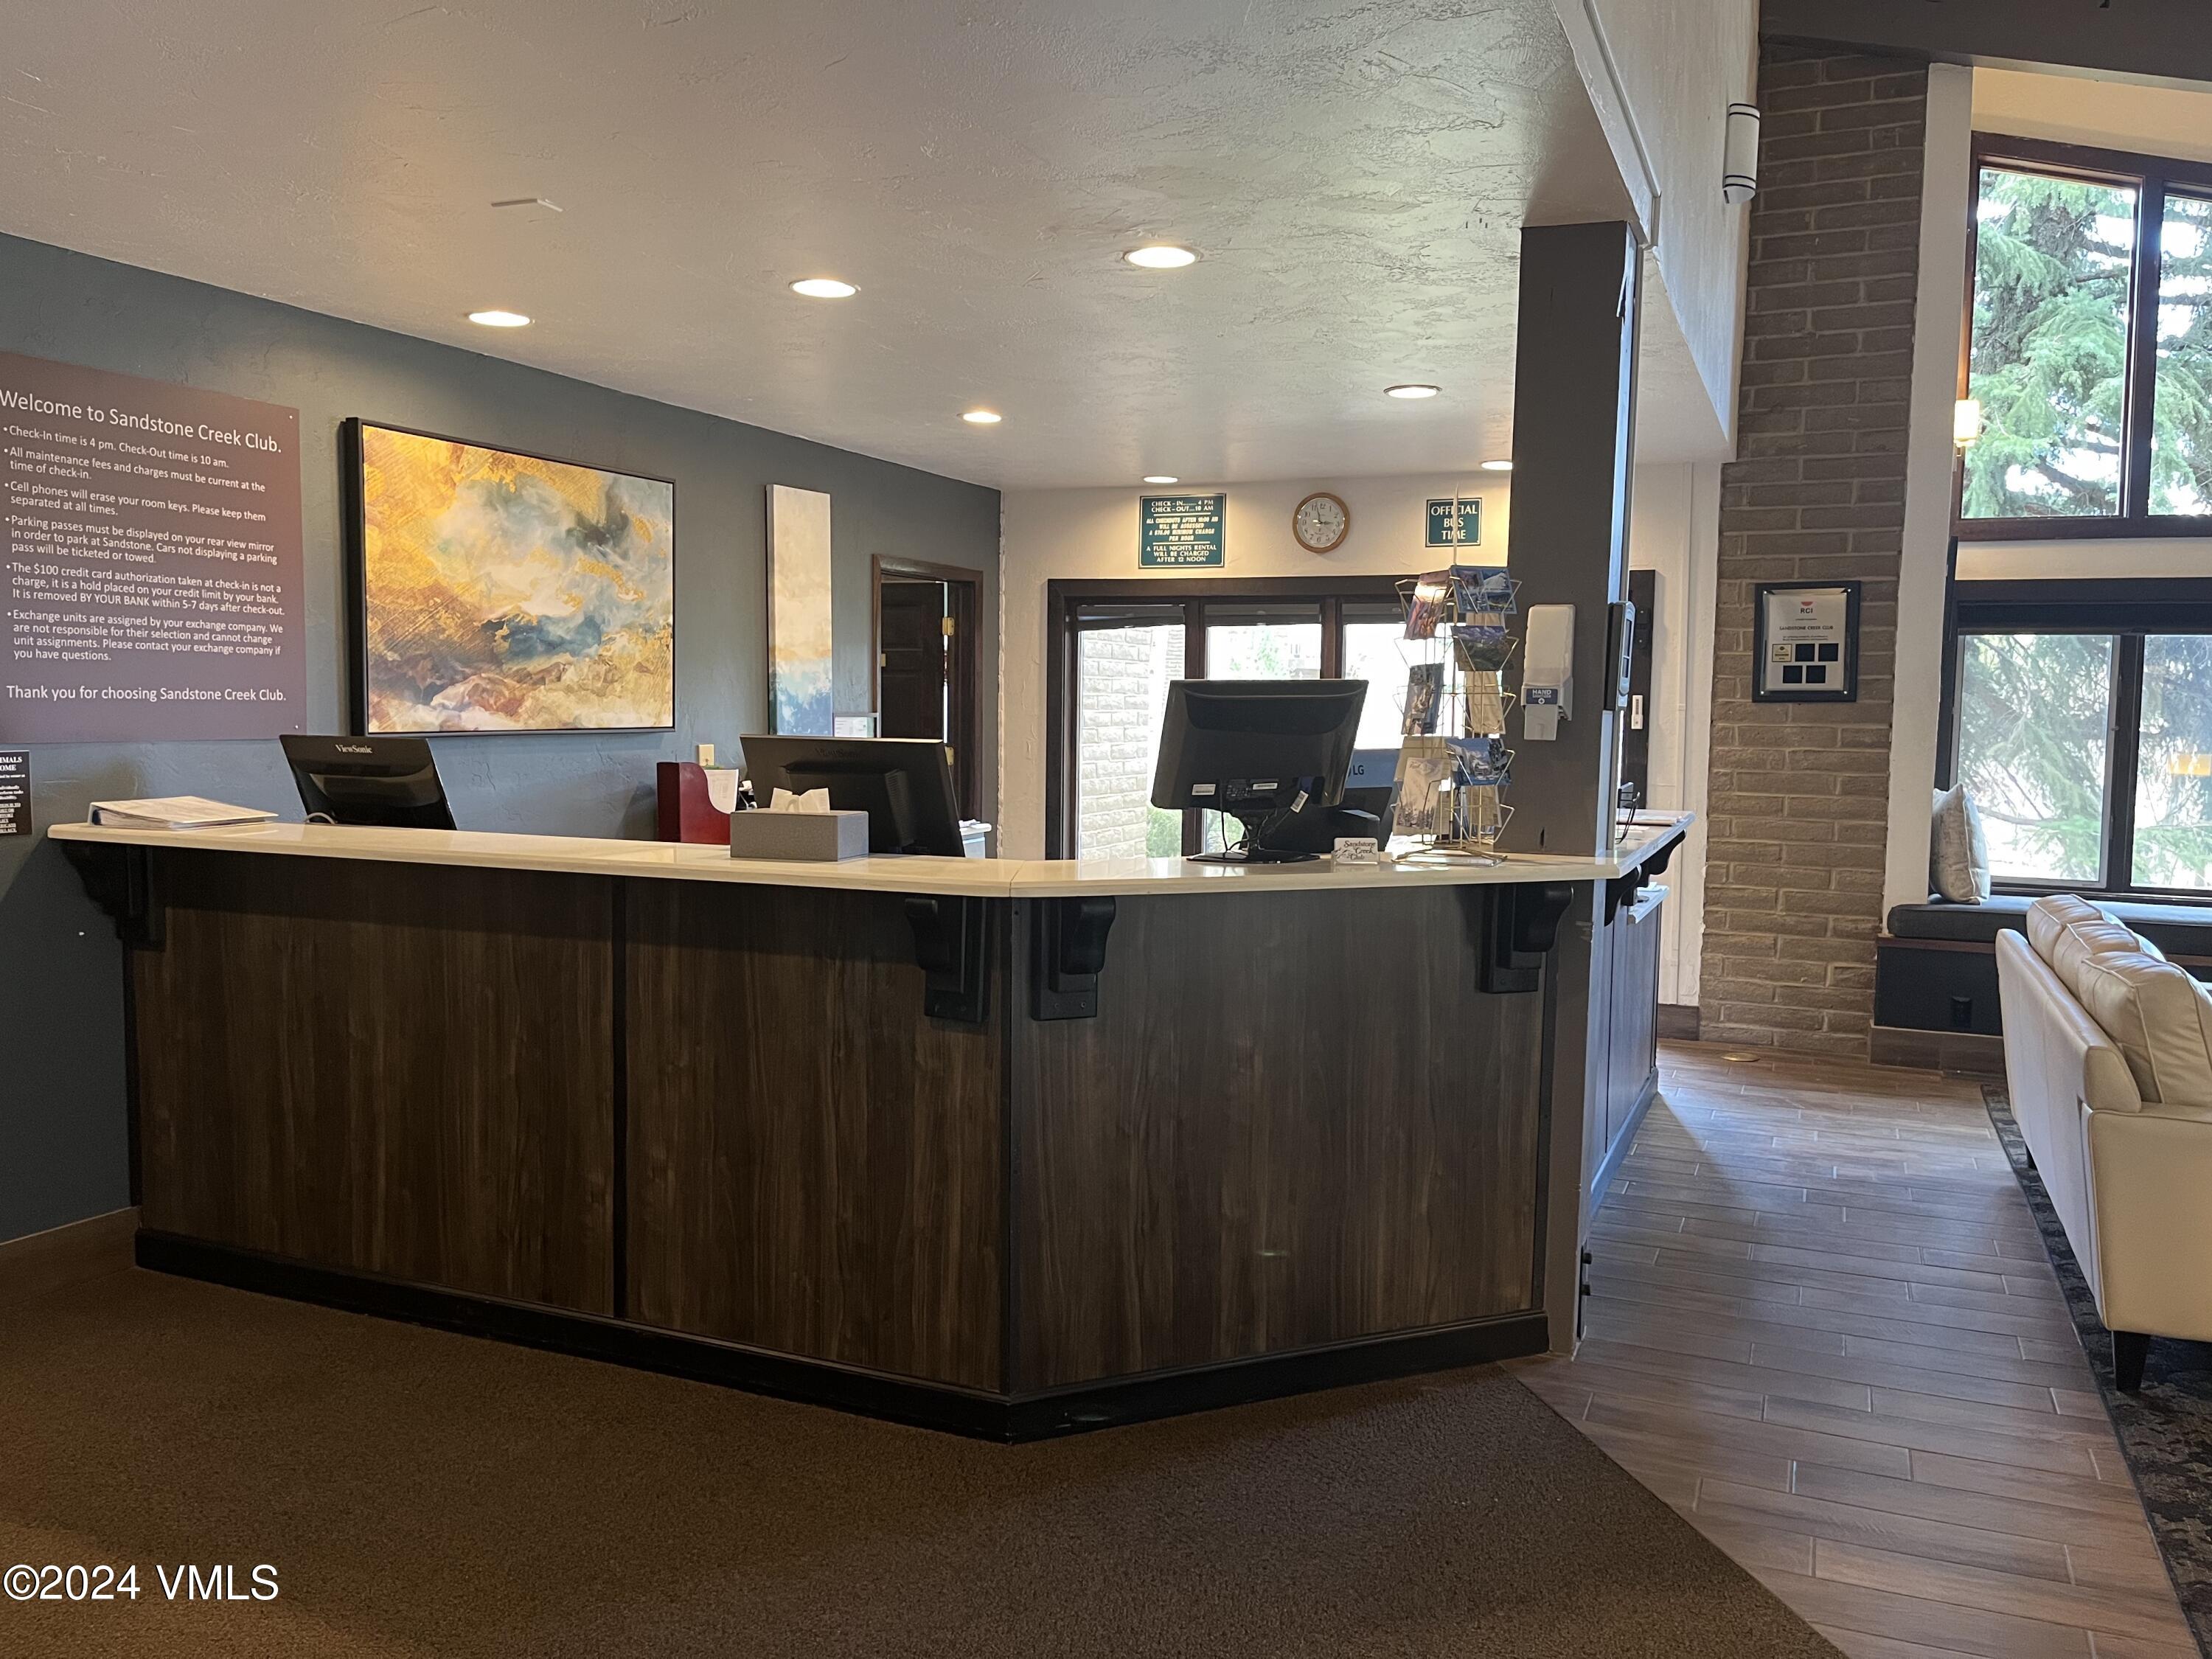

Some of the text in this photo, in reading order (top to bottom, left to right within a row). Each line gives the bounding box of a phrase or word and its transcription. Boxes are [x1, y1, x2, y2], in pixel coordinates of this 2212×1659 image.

[0, 389, 282, 453] Welcome to Sandstone Creek Club.
[9, 425, 229, 468] Check-In time is 4 pm. Check-Out time is 10 am.
[10, 446, 265, 492] All maintenance fees and charges must be current at the
[10, 460, 92, 479] time of check-in.
[10, 481, 266, 521] Cell phones will erase your room keys. Please keep them
[11, 496, 118, 515] separated at all times.
[1431, 505, 1477, 516] OFFIIAL
[12, 515, 273, 552] Parking passes must be displayed on your rear view mirror
[1441, 530, 1466, 540] TIME
[12, 543, 34, 553] pass
[37, 544, 54, 554] will
[57, 545, 69, 556] be
[72, 546, 109, 559] ticketed
[125, 552, 157, 563] towed.
[12, 562, 31, 573] The
[33, 564, 59, 575] $100
[61, 567, 90, 578] credit
[91, 570, 112, 579] card
[114, 571, 176, 584] authorization
[178, 576, 203, 586] taken
[204, 579, 213, 588] at
[215, 579, 250, 590] check-in
[252, 582, 259, 591] is
[260, 584, 274, 592] not
[13, 588, 285, 616] It is removed BY YOUR BANK within 5-7 days after check-out.
[13, 609, 283, 634] Exchange units are assigned by your exchange company. We
[13, 624, 272, 646] are not responsible for their selection and cannot change
[14, 635, 281, 657] unit assignments. Please contact your exchange company if
[13, 648, 111, 661] you have questions.
[6, 685, 287, 702] Thank you for choosing Sandstone Creek Club.
[335, 744, 372, 754] ViewSonic
[1353, 765, 1364, 775] LG
